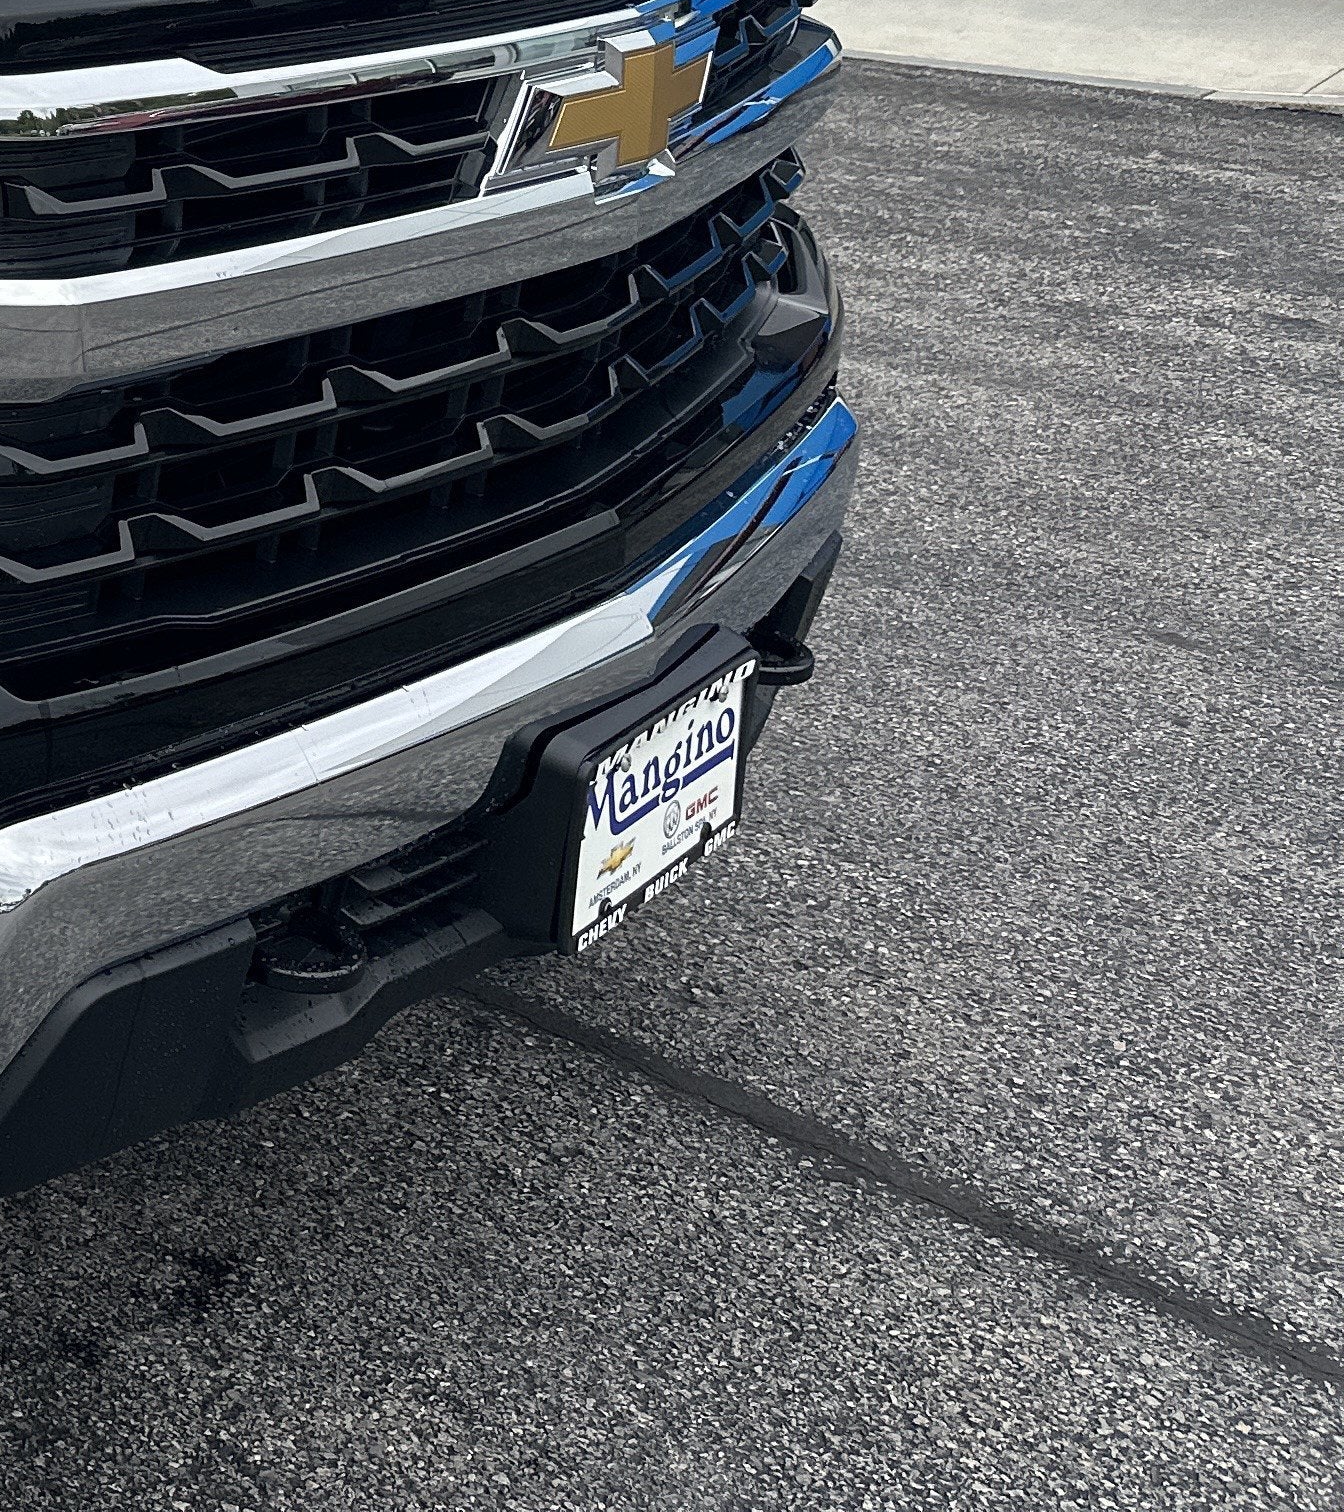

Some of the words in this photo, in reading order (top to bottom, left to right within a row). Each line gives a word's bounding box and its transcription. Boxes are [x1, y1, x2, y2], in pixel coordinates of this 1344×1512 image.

[587, 707, 735, 833] Mangino
[685, 785, 719, 820] GMC
[661, 824, 694, 856] BALLSTON
[577, 903, 628, 952] CHEVY
[643, 857, 690, 904] BUICK
[704, 820, 737, 857] GMC
